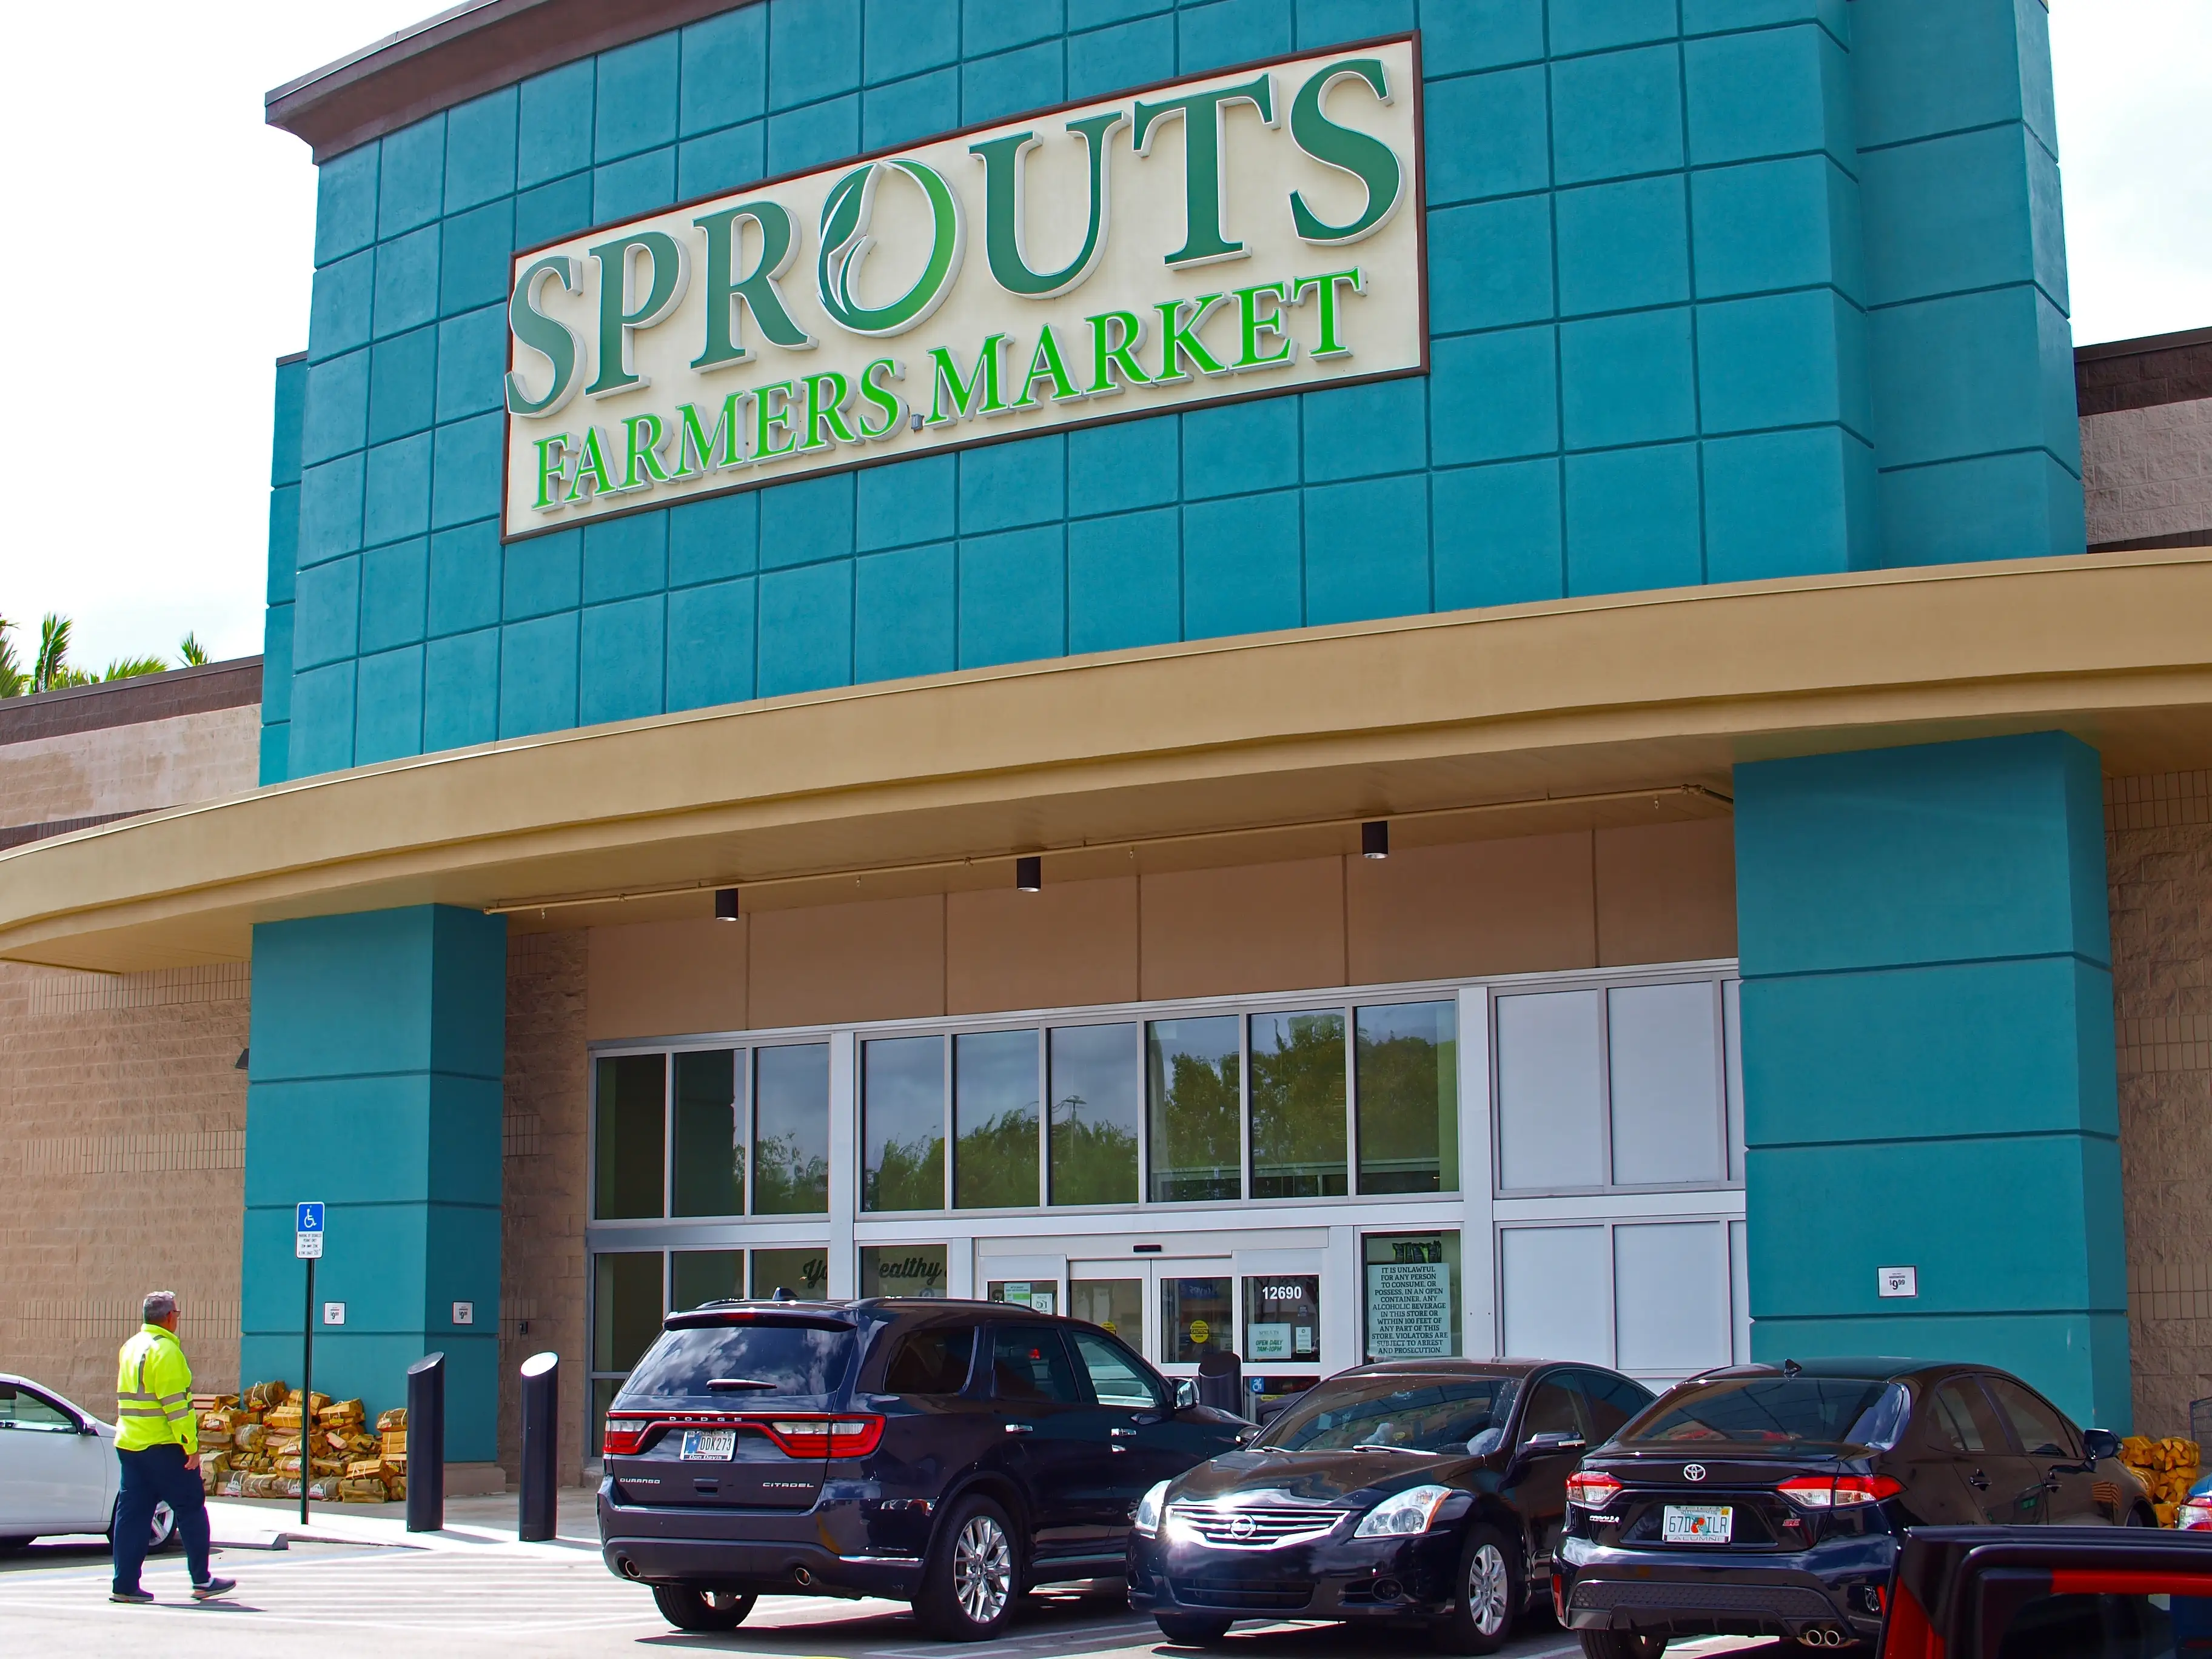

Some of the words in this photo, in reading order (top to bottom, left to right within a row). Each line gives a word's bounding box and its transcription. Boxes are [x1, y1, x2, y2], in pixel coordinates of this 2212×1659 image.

[505, 58, 1406, 418] SPROUTS
[532, 358, 910, 513] FARMERS
[924, 266, 1369, 427] MARKET
[879, 1257, 942, 1285] ealthy
[1262, 1286, 1302, 1300] 12690
[700, 1437, 732, 1451] DDK273
